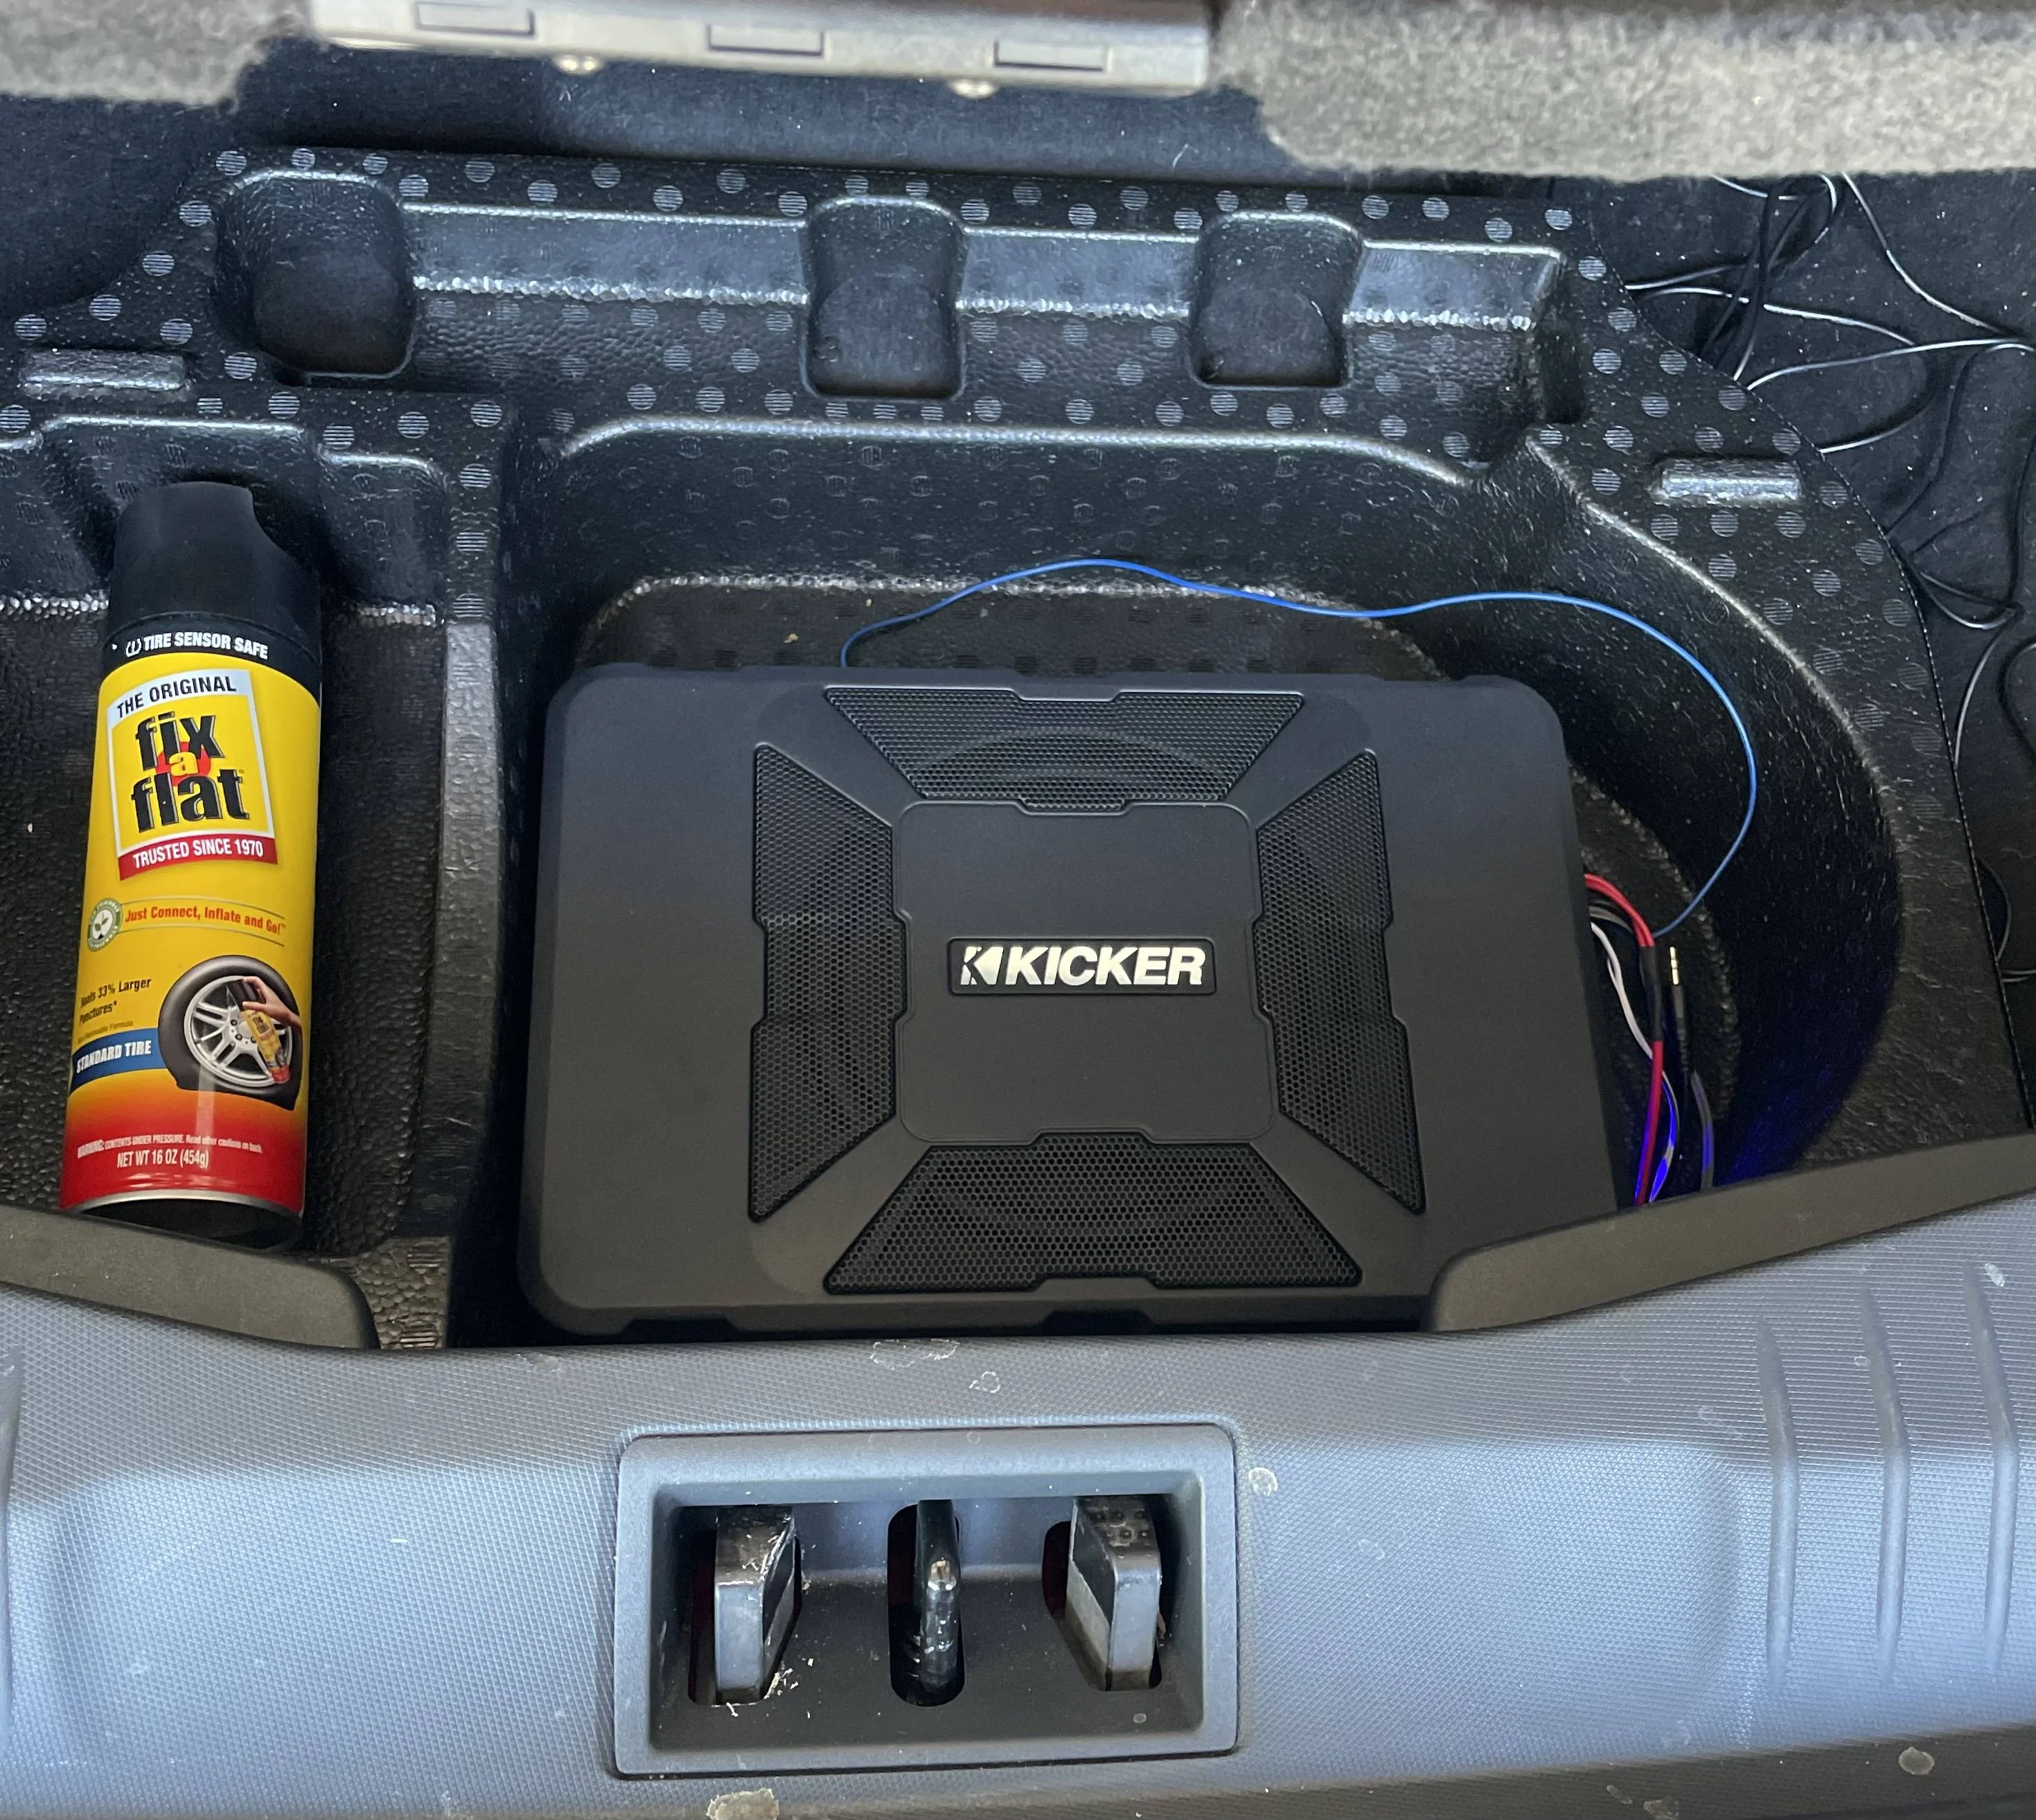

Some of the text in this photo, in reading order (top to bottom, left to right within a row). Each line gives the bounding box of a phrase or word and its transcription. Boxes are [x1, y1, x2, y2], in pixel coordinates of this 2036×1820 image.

[143, 632, 268, 660] TIRE SENSOR SAFE
[117, 675, 237, 718] THE ORIGINAL
[135, 712, 227, 771] fix
[169, 752, 199, 777] a
[131, 768, 250, 833] flat
[133, 838, 264, 869] TRUSTED SINCE 1970
[125, 907, 147, 923] Just
[151, 906, 201, 920] Connect,
[204, 906, 240, 923] Inflate
[244, 914, 263, 929] and
[1005, 946, 1206, 987] KICKER
[98, 983, 116, 998] 33%
[118, 978, 152, 992] Larger
[76, 1040, 152, 1073] STANDARD TIRE
[186, 1135, 201, 1144] Read
[116, 1149, 209, 1169] NET WT 16 OZ (454g)
